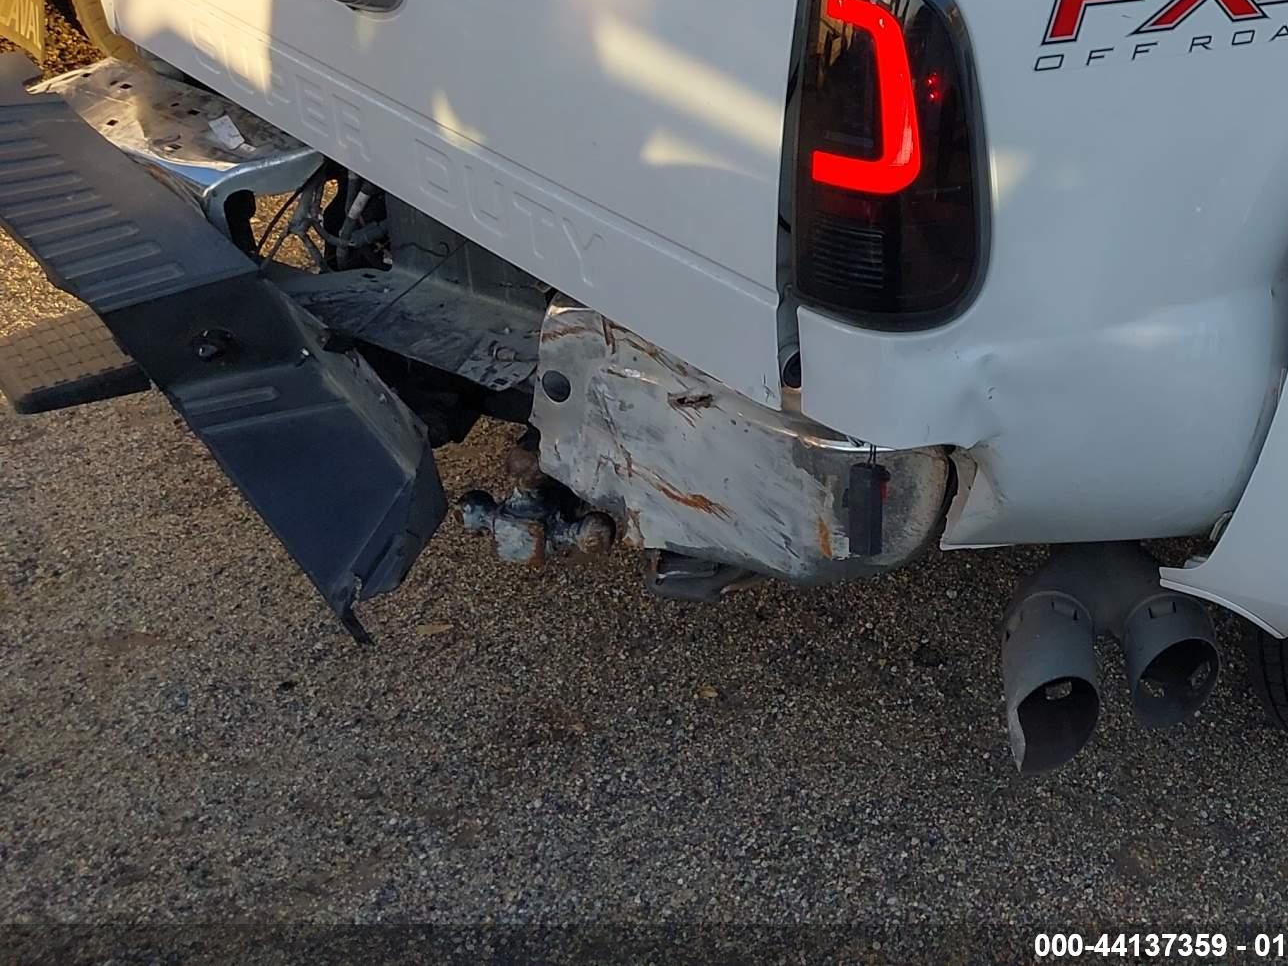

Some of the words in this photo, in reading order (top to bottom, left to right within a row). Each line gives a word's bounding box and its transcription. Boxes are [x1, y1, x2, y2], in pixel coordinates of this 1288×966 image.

[1033, 41, 1159, 72] OFF
[190, 16, 372, 164] SUPER
[413, 137, 606, 290] DUTY
